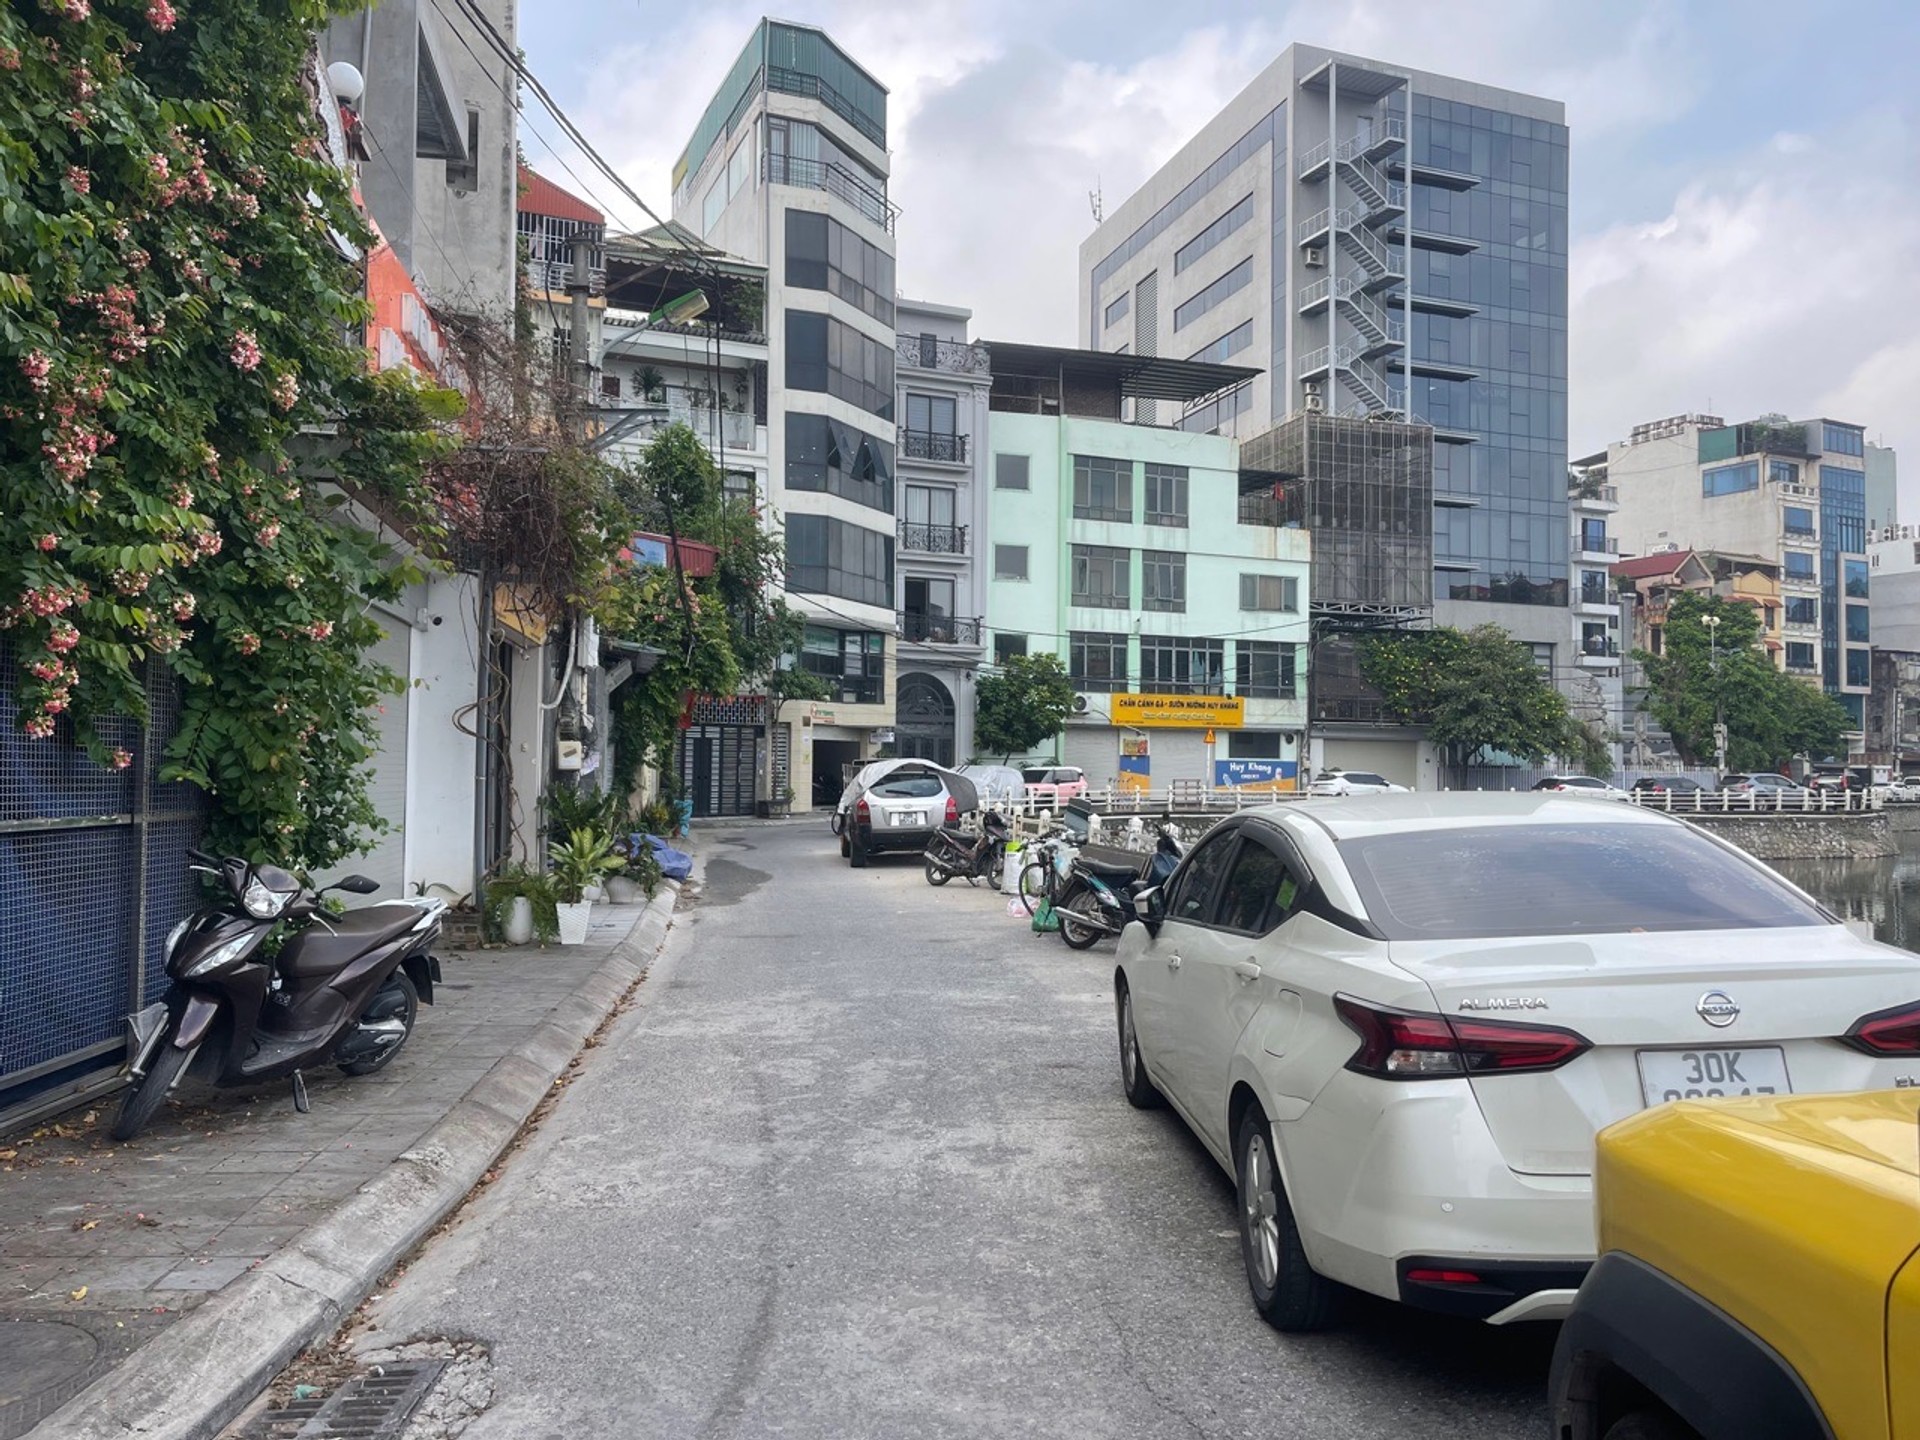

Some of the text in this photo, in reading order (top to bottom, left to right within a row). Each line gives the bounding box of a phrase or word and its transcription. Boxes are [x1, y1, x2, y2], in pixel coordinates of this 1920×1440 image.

[1229, 762, 1272, 775] Huy Khang
[1459, 997, 1549, 1011] ALMERA
[1700, 1004, 1736, 1014] NISSAN
[1681, 1052, 1747, 1084] 30K
